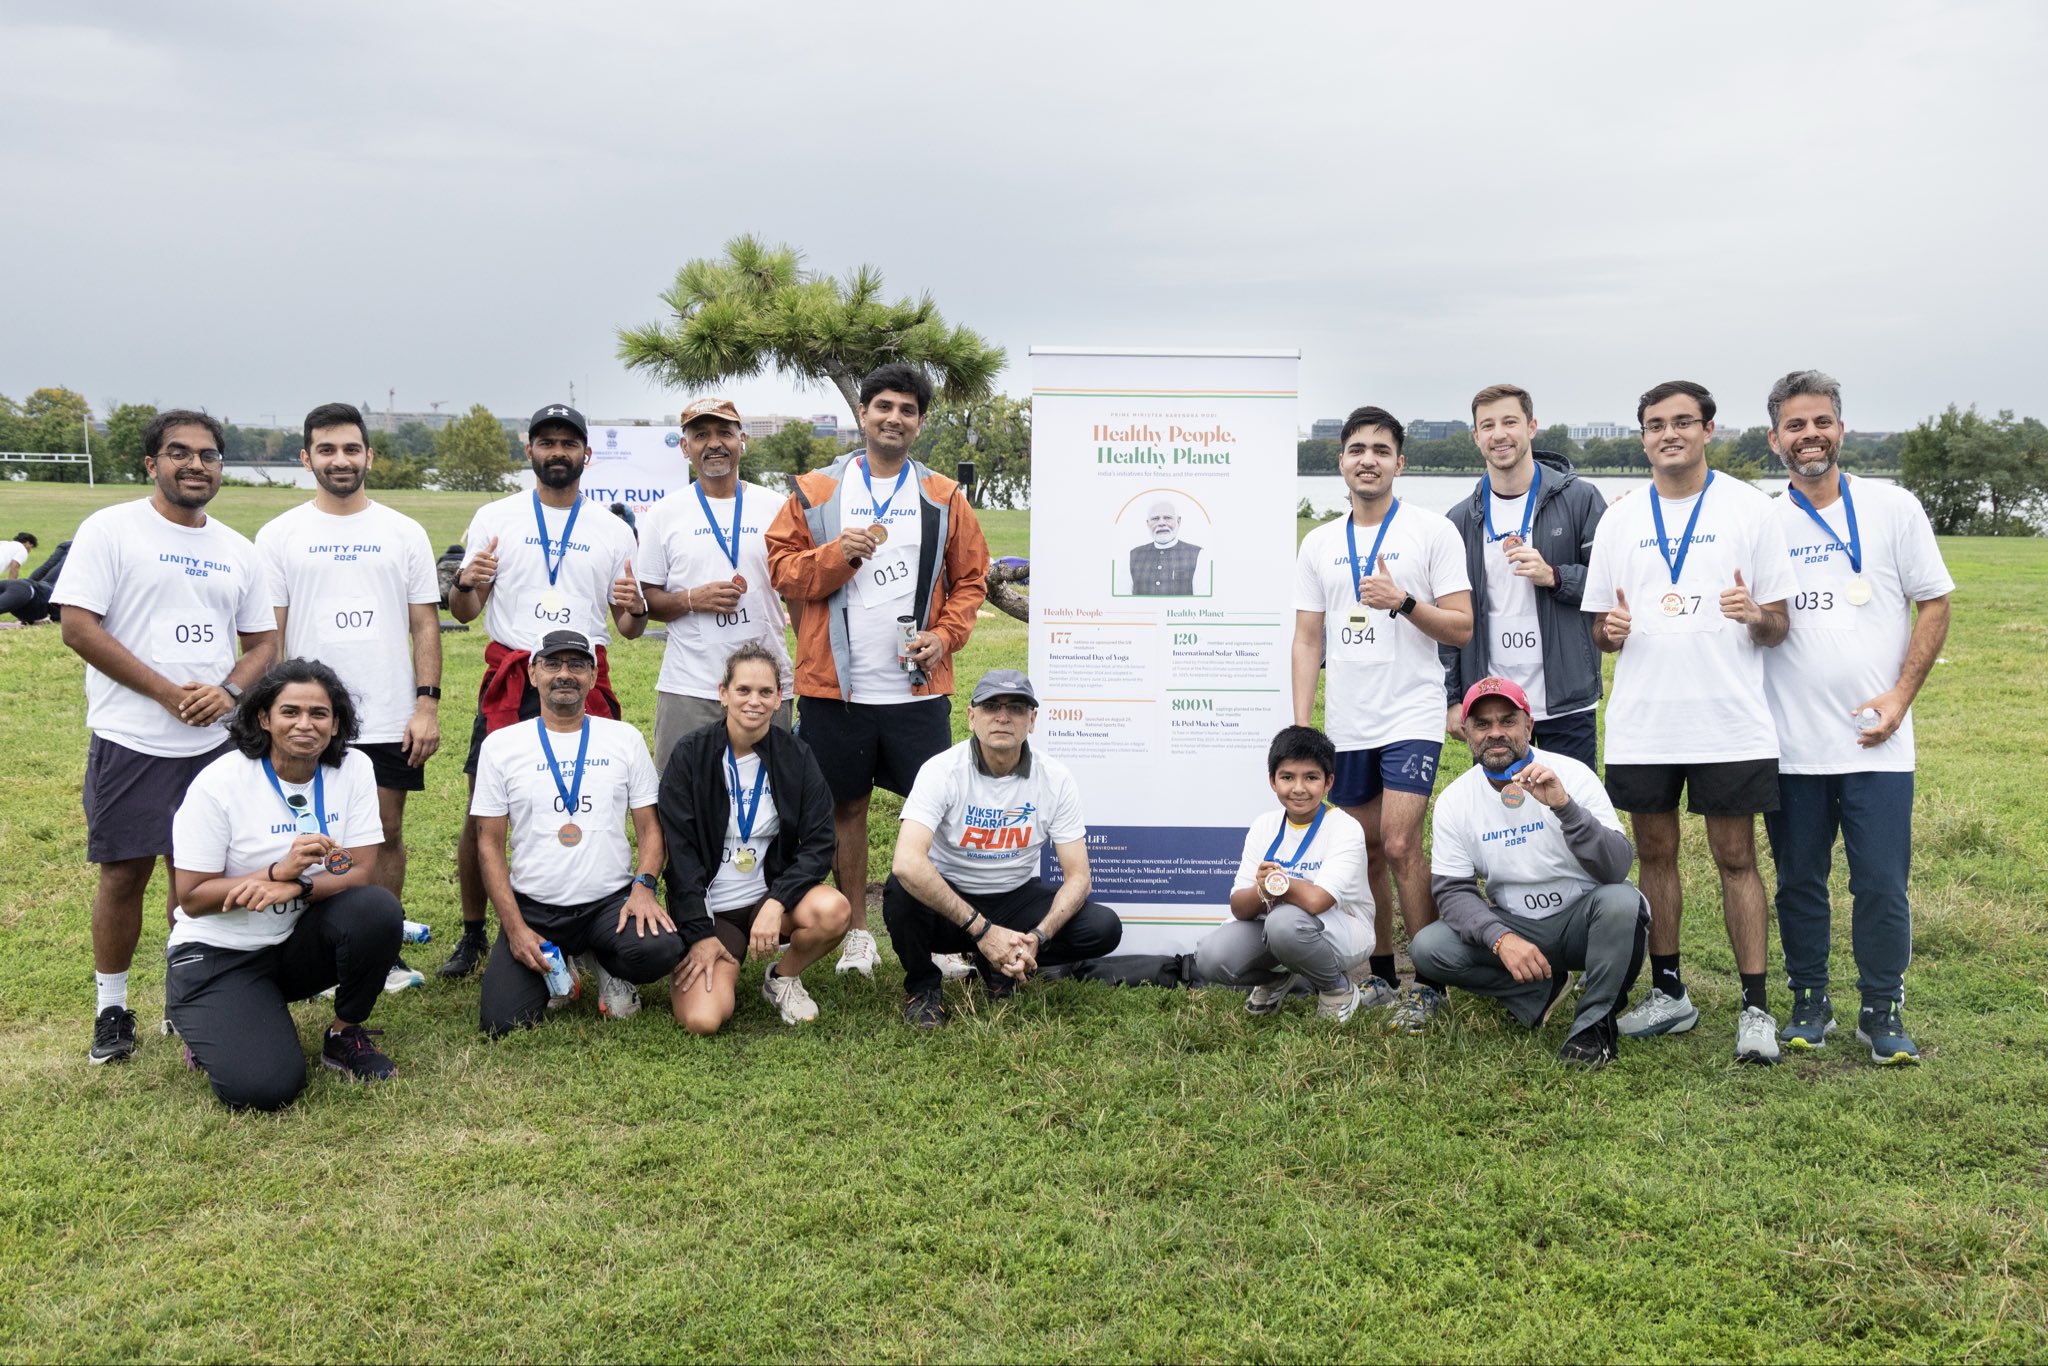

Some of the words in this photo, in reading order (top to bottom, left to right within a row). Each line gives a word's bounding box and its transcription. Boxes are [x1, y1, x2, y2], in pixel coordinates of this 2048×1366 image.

[1093, 424, 1166, 447] Healthy
[1169, 424, 1237, 447] People,
[1097, 446, 1169, 470] Healthy
[1173, 447, 1231, 465] Planet
[624, 489, 665, 502] RUN
[890, 509, 917, 517] RUN
[308, 545, 350, 553] UNITY
[352, 544, 381, 553] RUN
[1788, 545, 1822, 557] NITY
[159, 553, 200, 567] UNITY
[203, 561, 231, 573] RUN
[1804, 554, 1830, 564] 2026
[184, 567, 209, 577] 2026
[873, 561, 909, 587] 013
[1795, 591, 1834, 611] 033
[335, 610, 374, 629] 007
[1043, 608, 1074, 618] Healthy
[1076, 608, 1103, 619] People
[1166, 609, 1198, 619] Healthy
[1199, 609, 1225, 618] Planet
[175, 624, 214, 643] 035
[1173, 633, 1198, 645] 120
[1341, 627, 1376, 645] 034
[1501, 631, 1537, 649] 006
[1049, 653, 1092, 661] International
[1092, 653, 1105, 662] Day
[1105, 653, 1113, 661] of
[1113, 654, 1130, 662] Yoga
[1171, 698, 1213, 711] 800M
[1048, 708, 1083, 721] 2019
[967, 804, 1004, 819] VIKSIT
[964, 815, 1009, 829] BHARAT
[1481, 827, 1517, 842] UNITY
[1521, 820, 1544, 835] RUN
[960, 826, 1032, 850] RUN
[1087, 835, 1108, 844] LiFE
[1504, 836, 1527, 847] 2026
[966, 851, 1010, 860] WASHINGTON
[1011, 850, 1020, 858] DC
[1179, 858, 1223, 866] Environmental
[1300, 861, 1323, 871] RUN
[1120, 867, 1136, 875] today
[1143, 867, 1166, 875] Mindful
[1094, 876, 1128, 884] Destructive
[1523, 891, 1563, 910] 009
